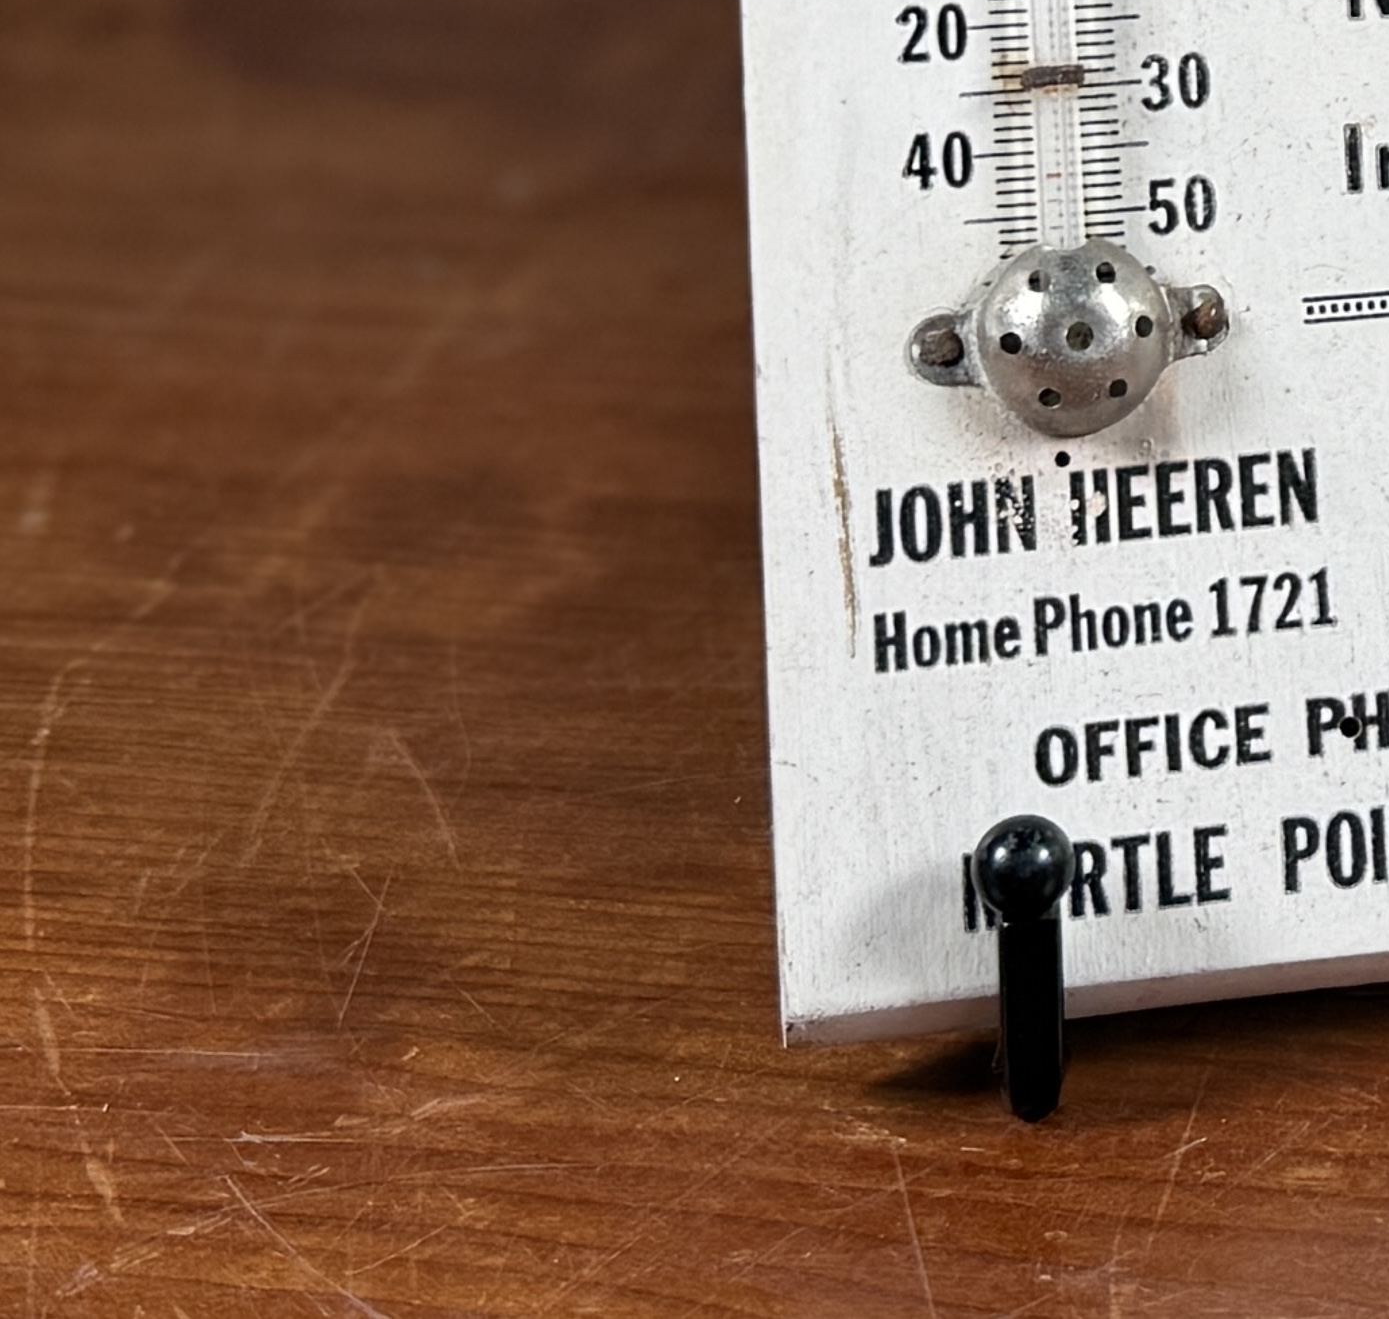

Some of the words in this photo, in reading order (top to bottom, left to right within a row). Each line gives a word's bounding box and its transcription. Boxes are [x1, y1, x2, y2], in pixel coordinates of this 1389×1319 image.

[895, 2, 968, 62] 20
[1140, 52, 1212, 110] 30
[902, 130, 974, 190] 40
[1147, 174, 1218, 234] 50
[868, 474, 1038, 568] JOHN
[1068, 446, 1320, 548] HEEREN
[872, 610, 1022, 674] Home
[1032, 592, 1194, 658] Phone
[1208, 566, 1336, 639] 1721
[1033, 702, 1273, 788] OFFICE
[962, 824, 1231, 933] RTLE
